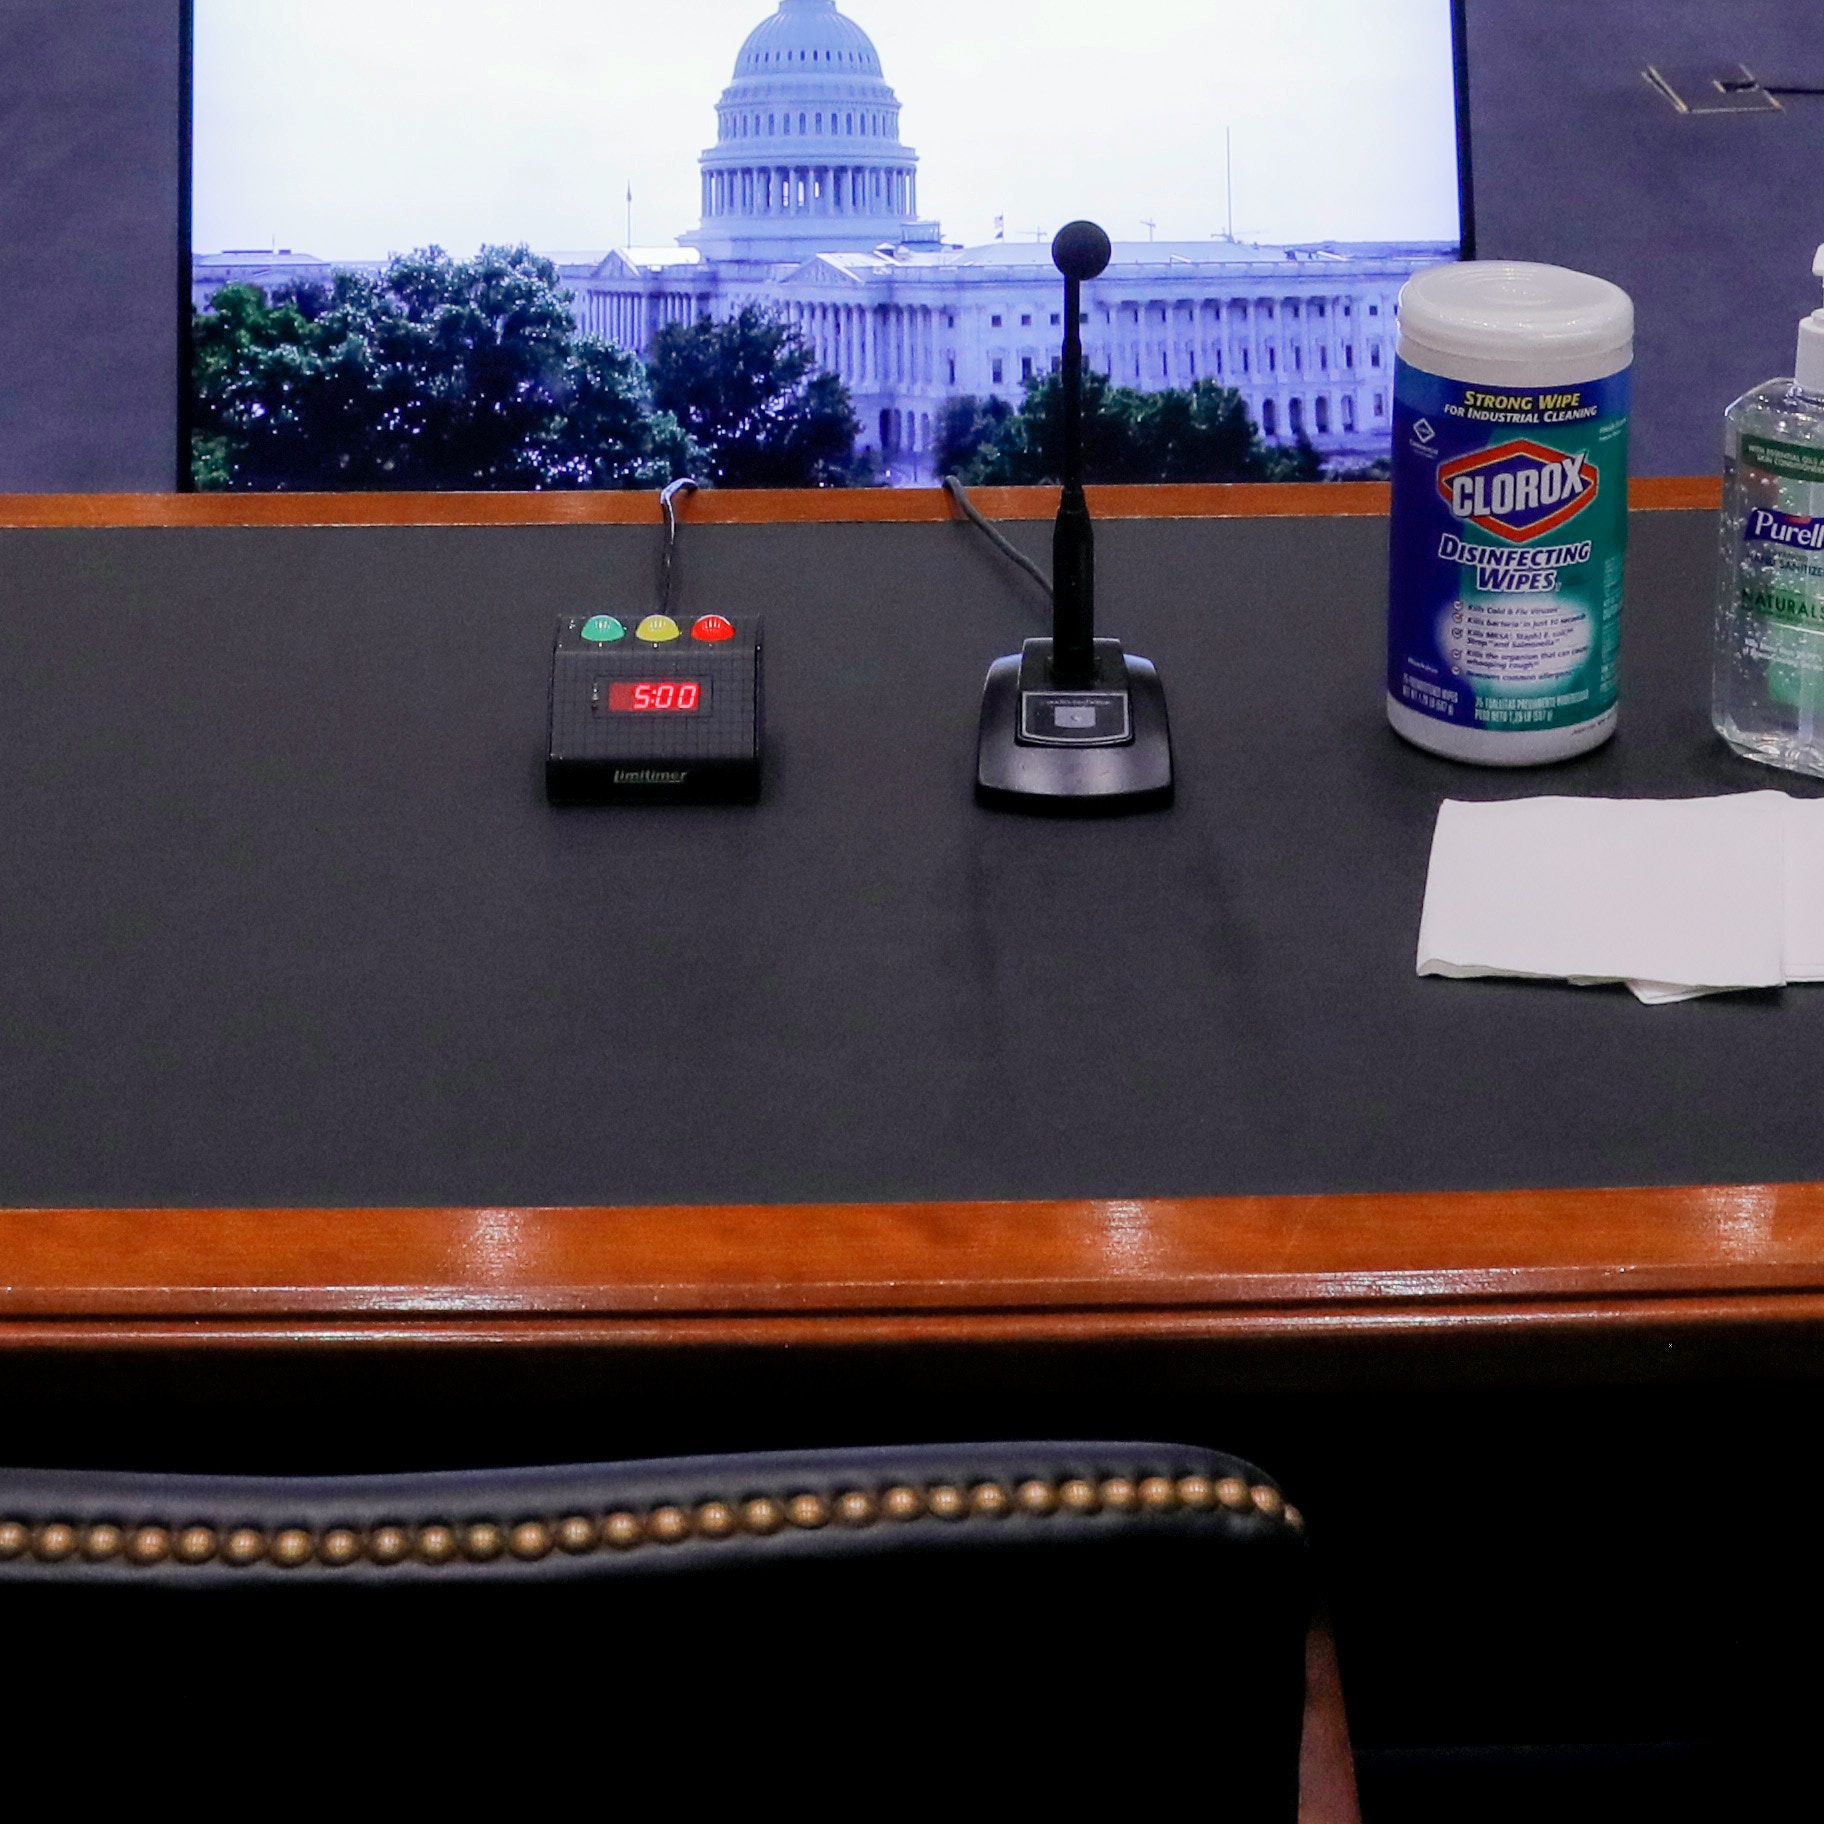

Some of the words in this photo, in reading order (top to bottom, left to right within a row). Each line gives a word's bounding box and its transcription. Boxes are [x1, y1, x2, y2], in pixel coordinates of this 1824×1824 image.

[1444, 404, 1465, 416] FOR
[1467, 408, 1539, 423] INDUSTRIAL
[1544, 405, 1597, 422] CLEANING
[1464, 391, 1533, 410] STRONG
[1539, 393, 1580, 409] WIPE
[1452, 454, 1587, 517] CLOROX
[1439, 533, 1591, 567] DISINFECTING
[1477, 566, 1556, 593] WIPES
[634, 684, 697, 709] 5:00
